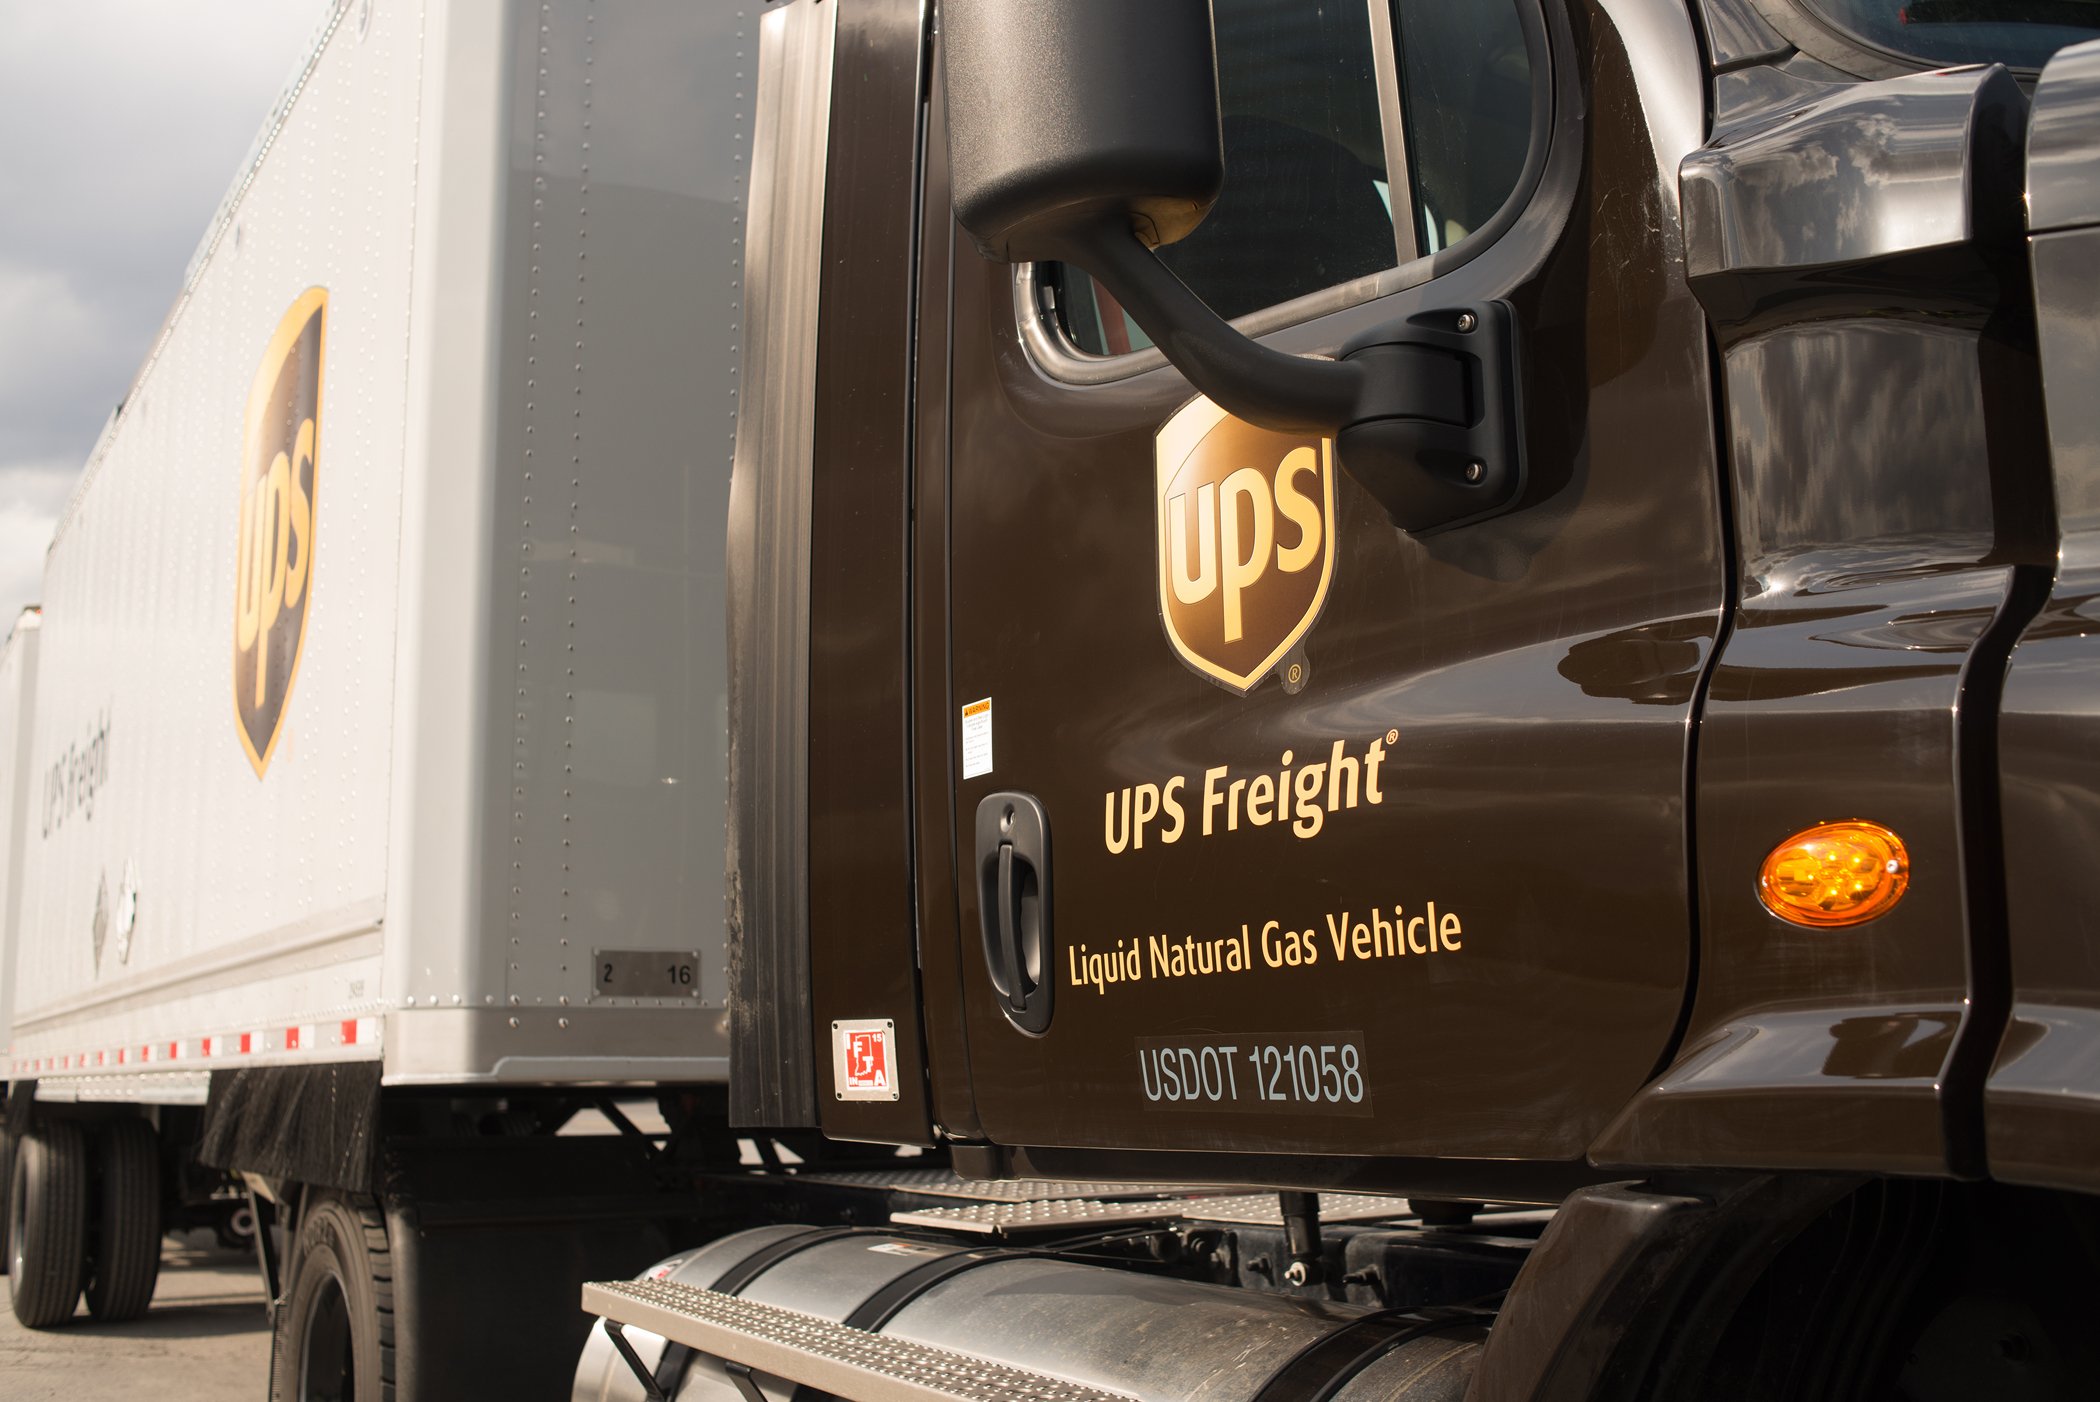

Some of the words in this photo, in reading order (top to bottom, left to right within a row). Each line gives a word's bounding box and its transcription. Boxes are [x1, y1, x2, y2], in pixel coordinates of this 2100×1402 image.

[1169, 446, 1323, 644] ups
[1105, 775, 1185, 854] UPS
[604, 963, 613, 983] 2
[667, 964, 690, 985] 16
[1069, 937, 1141, 995] Liquid
[1149, 924, 1251, 979] Natural
[1261, 920, 1318, 968] Gas
[1326, 901, 1462, 961] Vehicle
[872, 1033, 883, 1043] 15
[1140, 1046, 1237, 1101] USDOT
[1249, 1044, 1364, 1103] 121058
